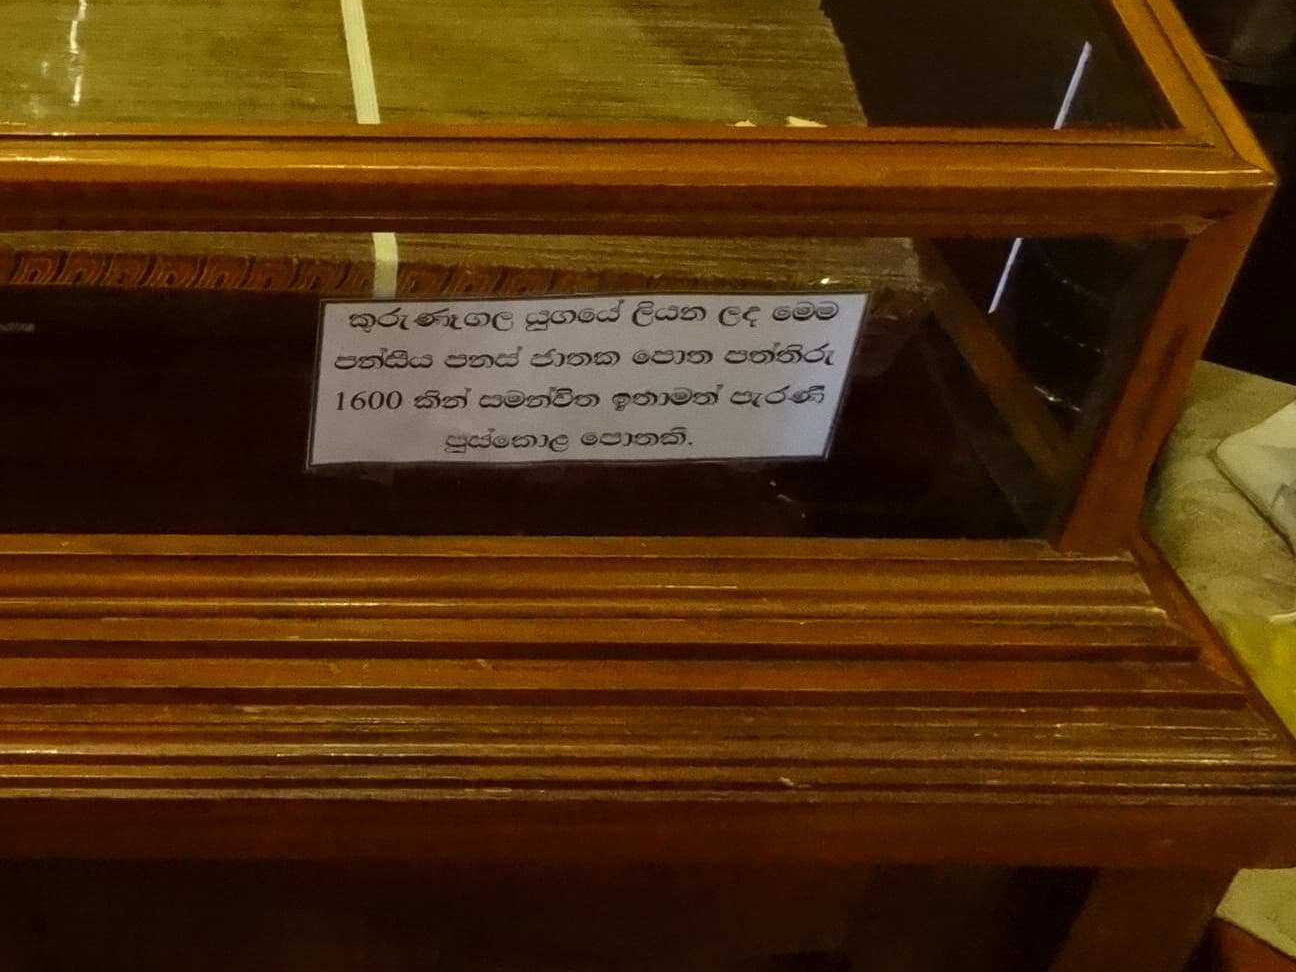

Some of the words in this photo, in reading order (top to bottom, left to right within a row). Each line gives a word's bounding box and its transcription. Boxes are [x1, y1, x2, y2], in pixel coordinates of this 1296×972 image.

[718, 306, 761, 328] ලද
[771, 302, 839, 322] මෙම
[444, 346, 524, 369] පනස්
[529, 348, 621, 368] ජාතක
[632, 349, 713, 365] පොත
[336, 390, 403, 413] 1600
[413, 387, 472, 410] කින්
[611, 384, 724, 411] ඉතාමත්
